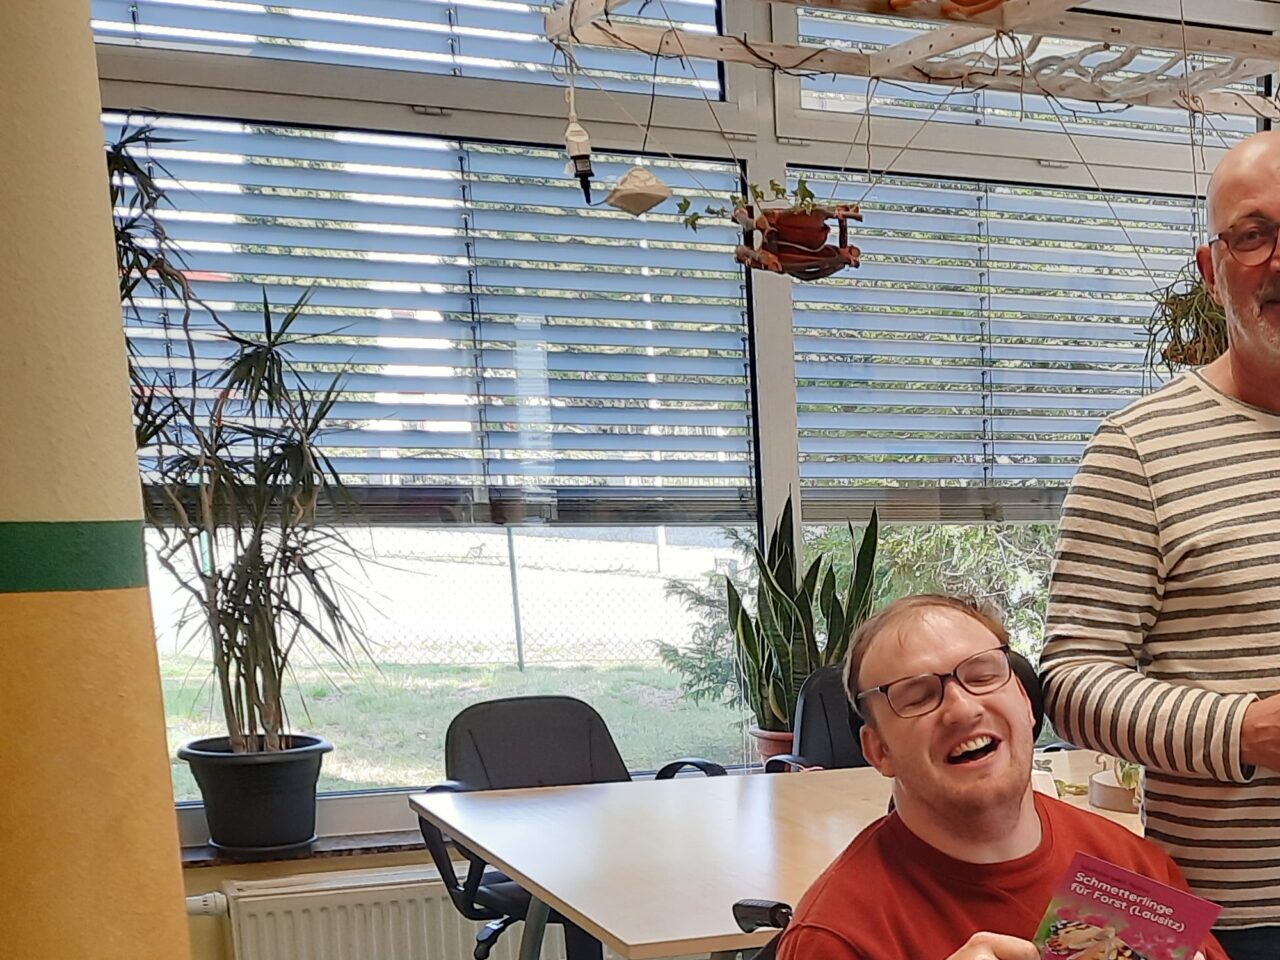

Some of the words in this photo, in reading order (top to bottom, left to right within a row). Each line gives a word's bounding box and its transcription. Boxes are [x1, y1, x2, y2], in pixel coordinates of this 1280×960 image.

[1070, 882, 1090, 898] für
[1092, 890, 1128, 910] Forst
[1129, 905, 1186, 933] (Lausitz)
[1074, 871, 1174, 916] Schmetterlinge
